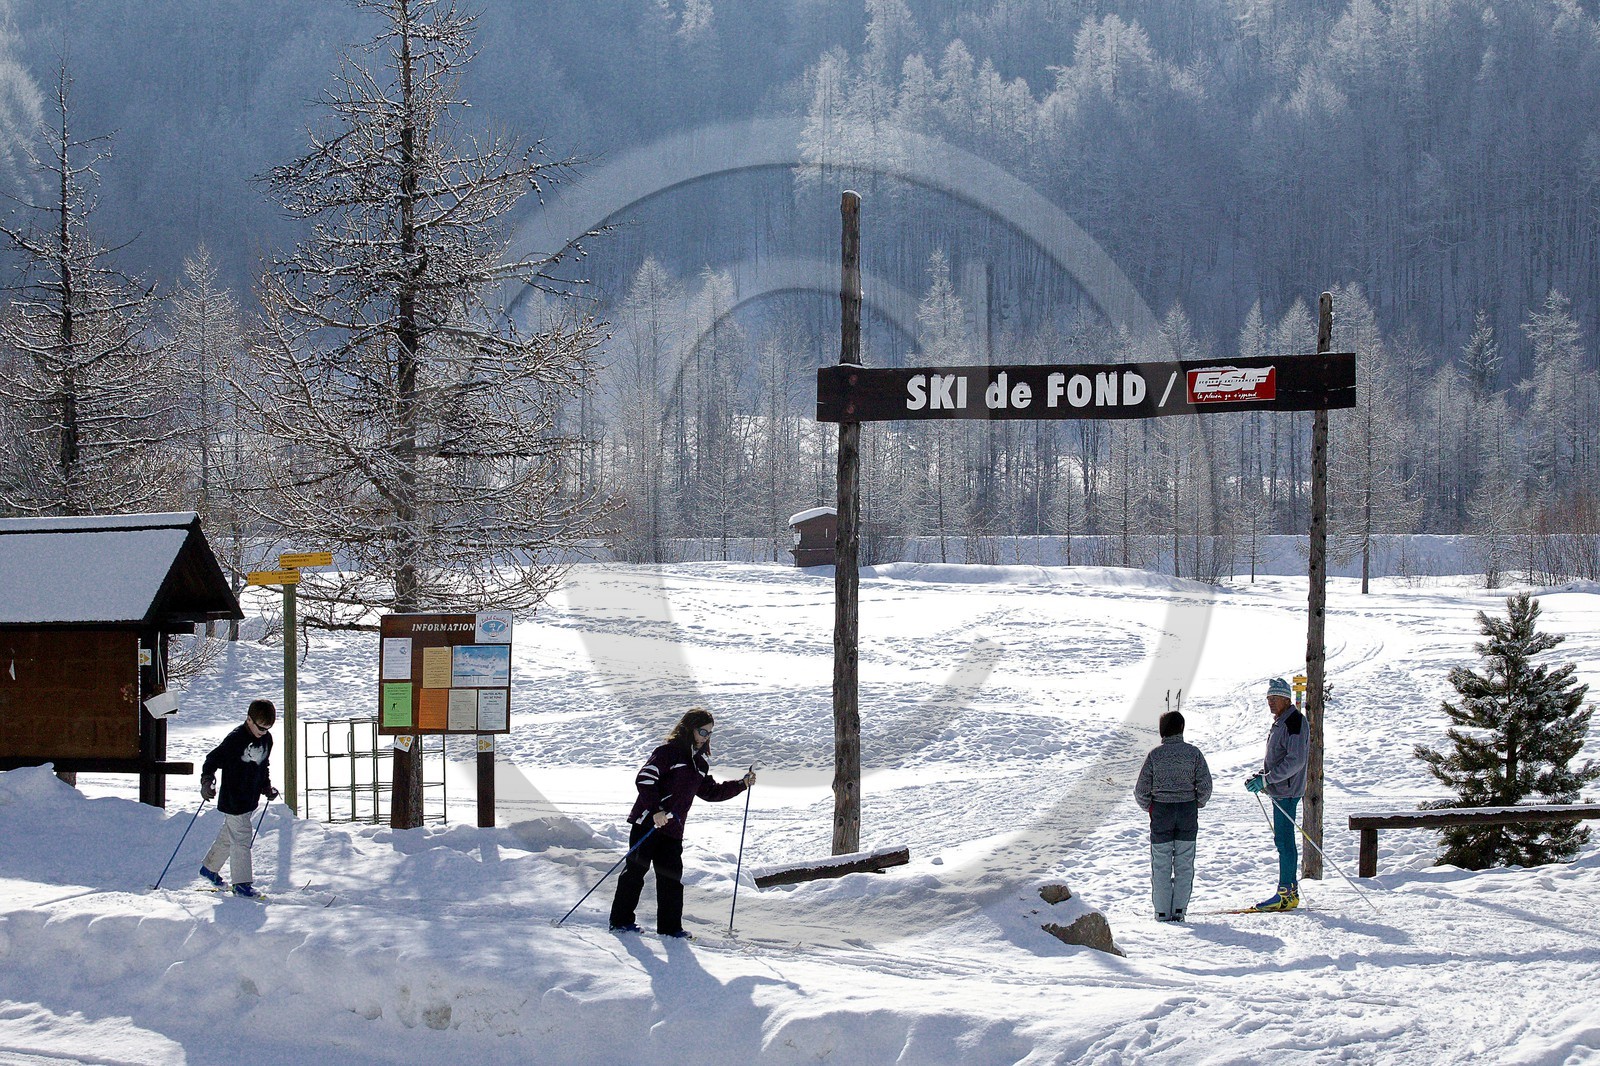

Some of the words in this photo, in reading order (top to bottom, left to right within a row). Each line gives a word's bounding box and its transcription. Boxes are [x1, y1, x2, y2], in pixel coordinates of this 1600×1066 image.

[906, 374, 967, 410] SKI
[985, 371, 1032, 409] de
[1047, 371, 1147, 408] FOND
[1193, 368, 1273, 393] ESF
[412, 623, 475, 632] INFORMATION
